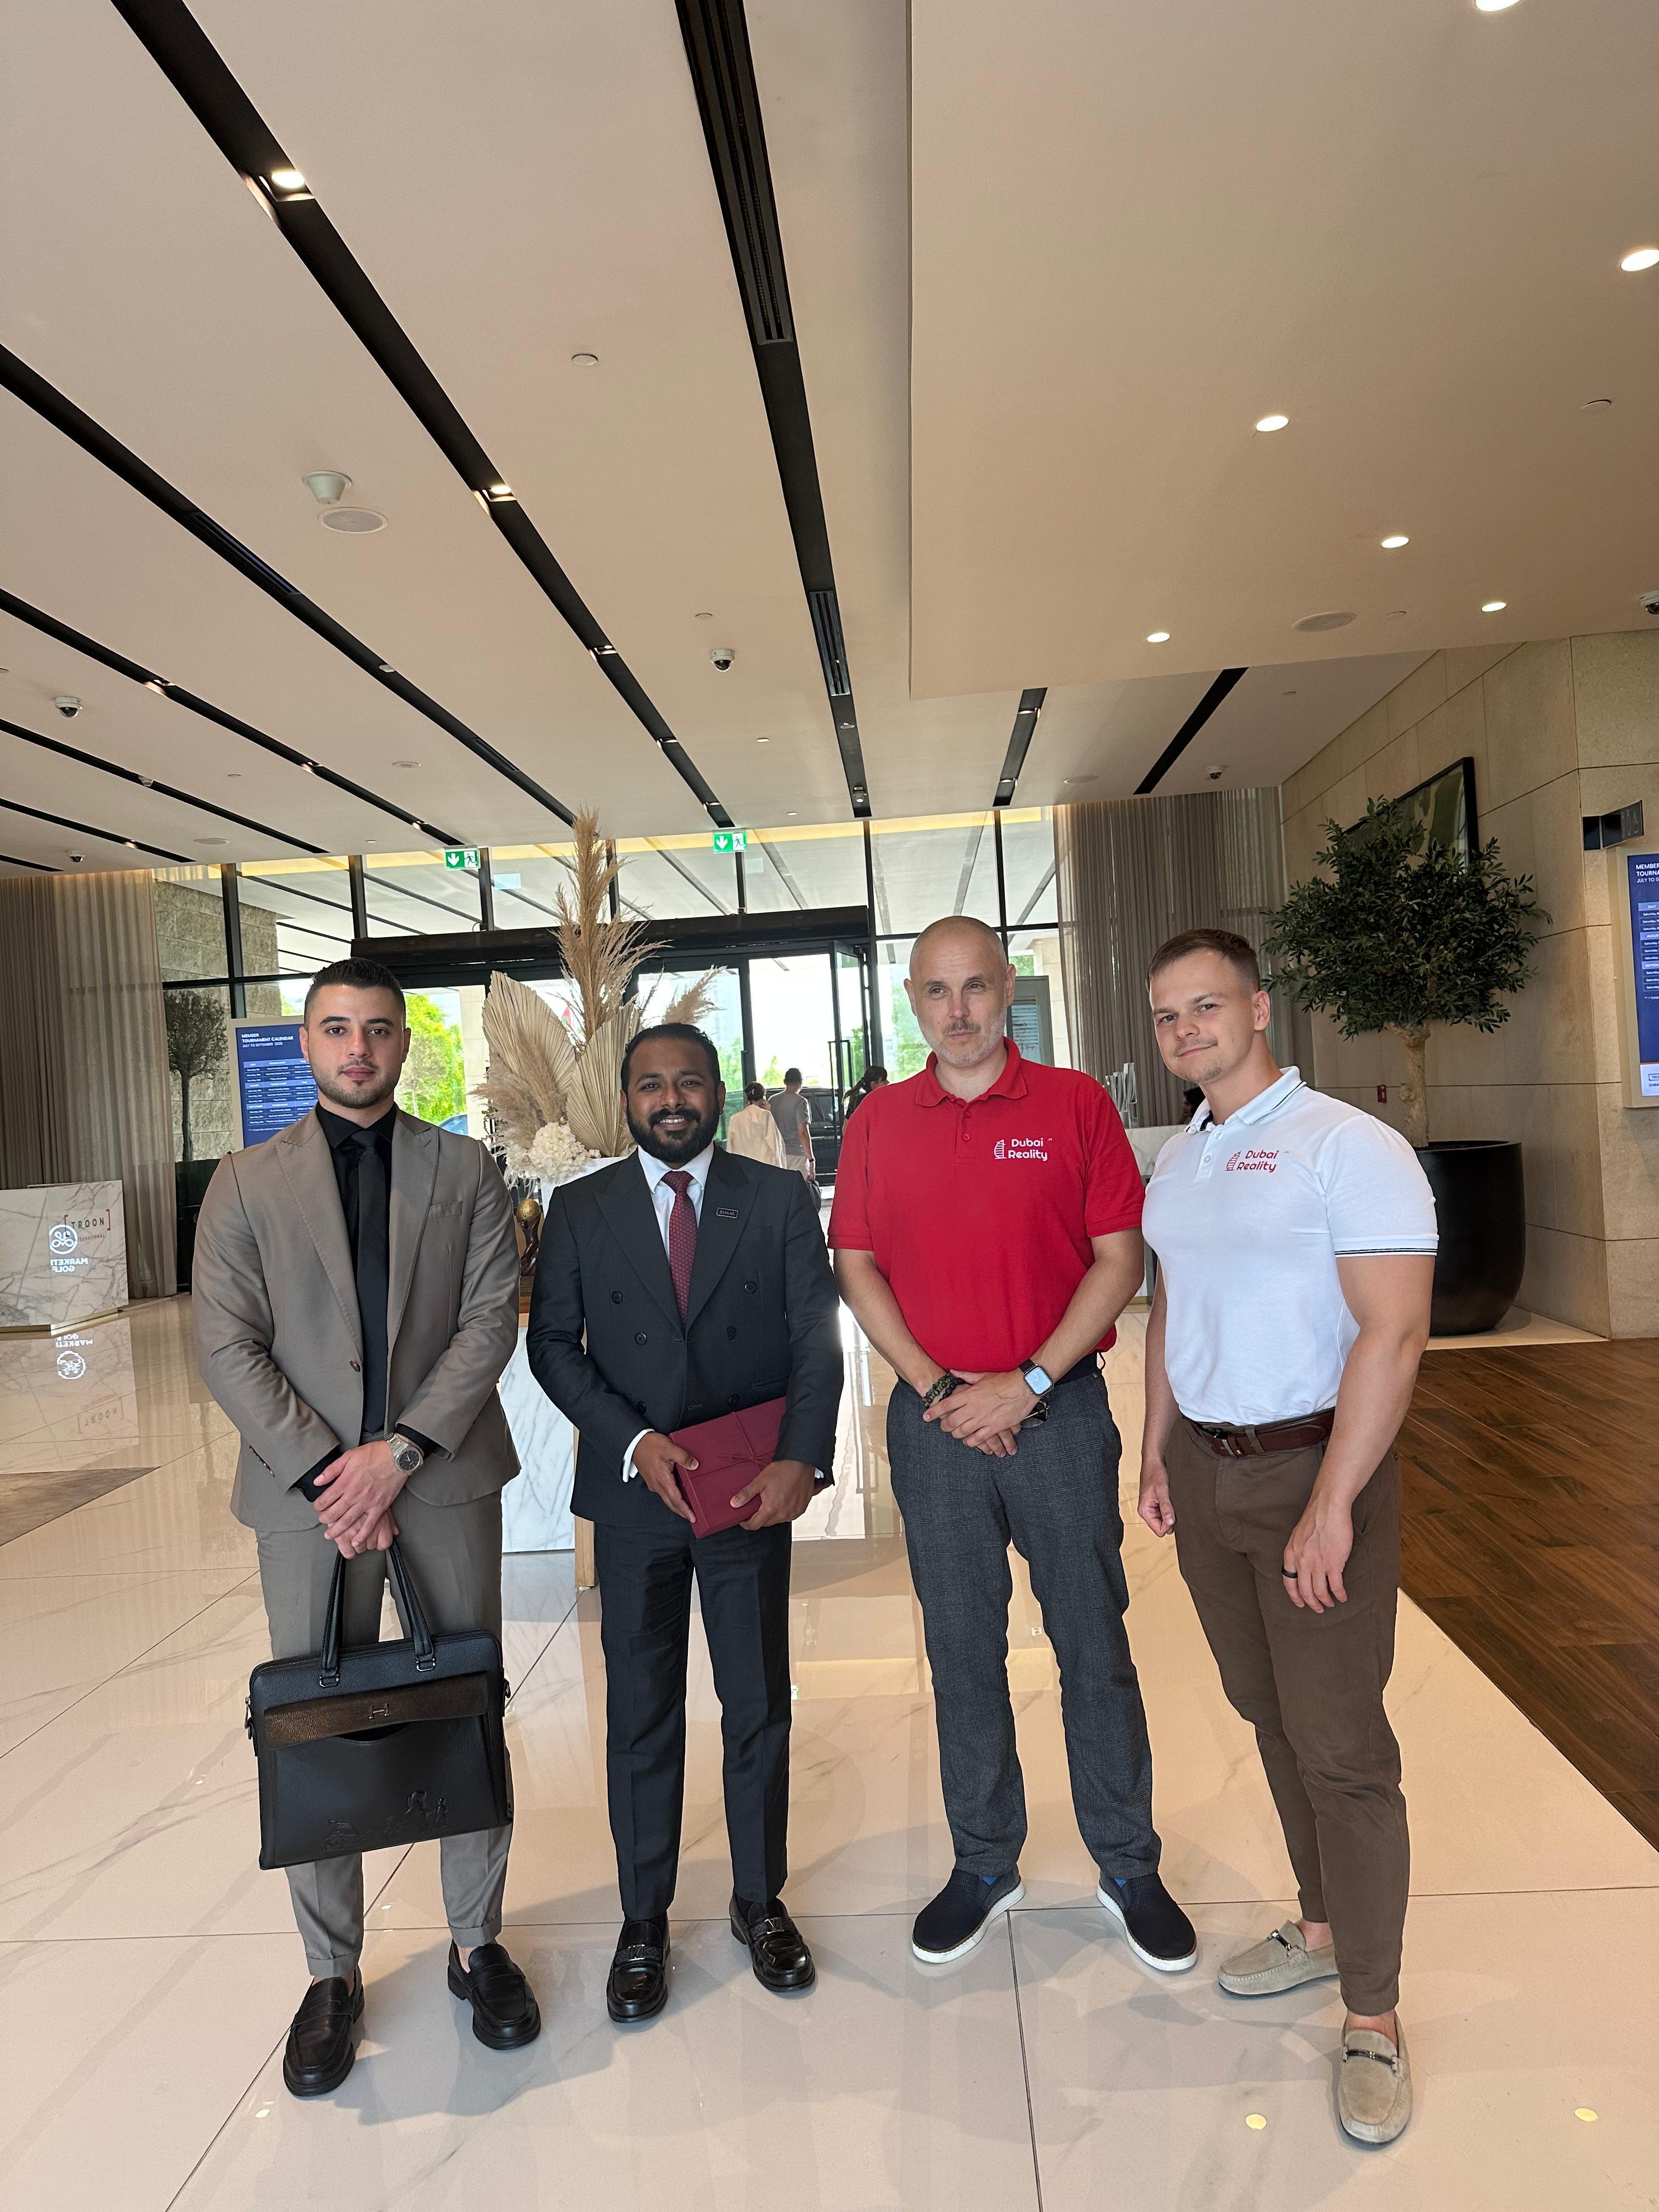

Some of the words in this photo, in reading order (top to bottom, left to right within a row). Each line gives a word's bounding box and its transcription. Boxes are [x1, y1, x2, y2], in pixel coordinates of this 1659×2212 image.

[1011, 1137, 1043, 1147] Dubai
[1008, 1149, 1048, 1161] Reality
[1245, 1149, 1279, 1159] Dubai
[1236, 1161, 1277, 1173] Reality
[71, 1217, 104, 1230] TROON
